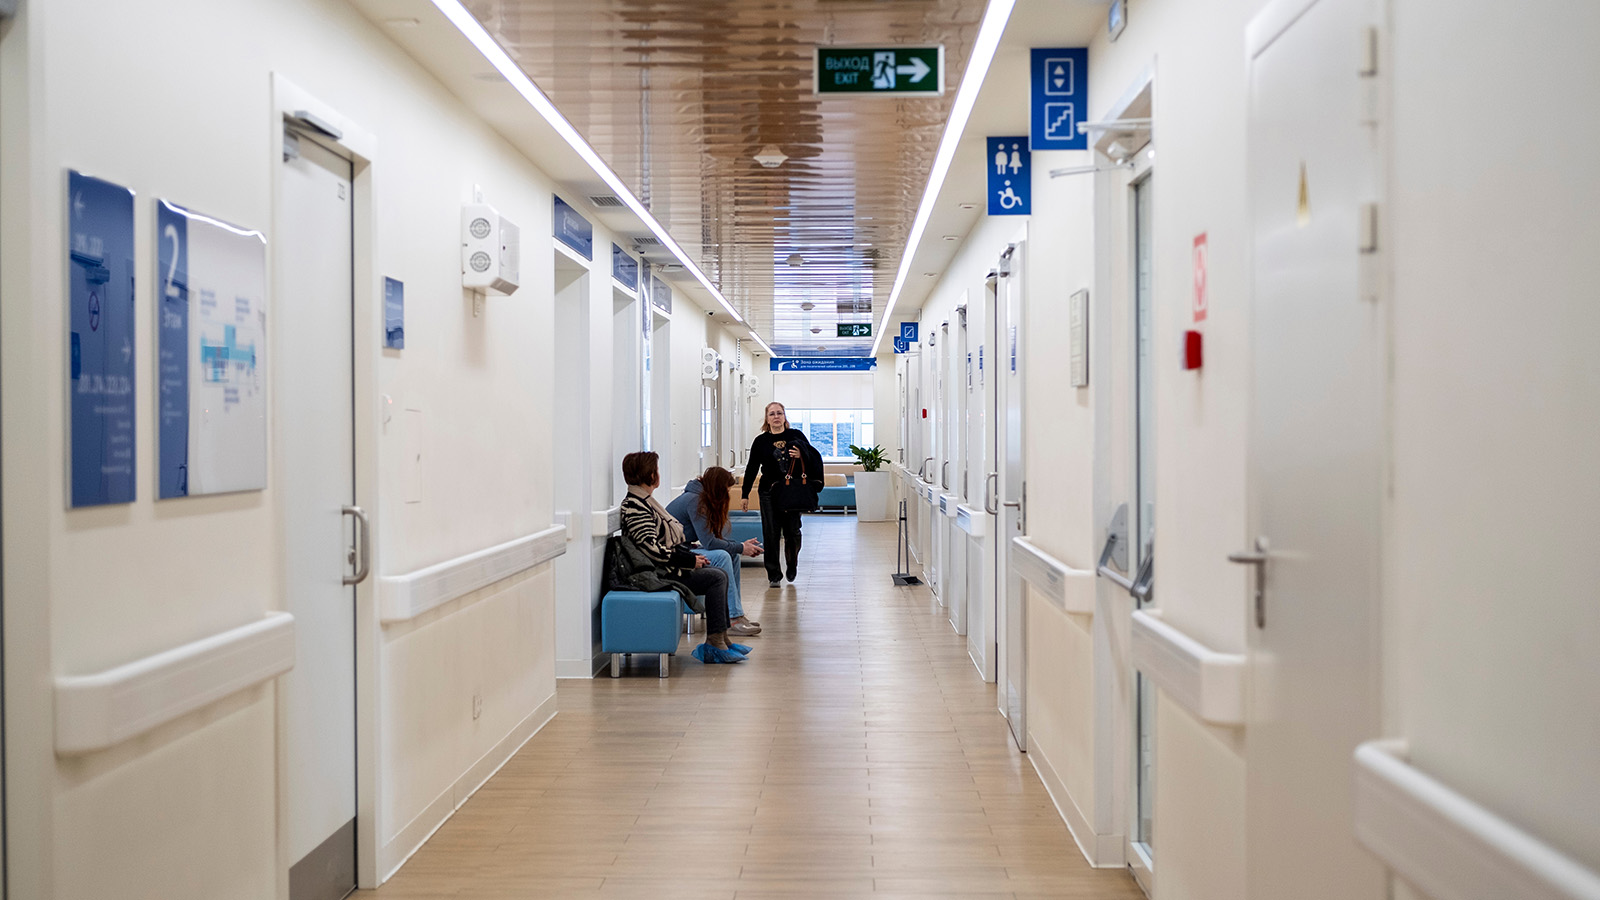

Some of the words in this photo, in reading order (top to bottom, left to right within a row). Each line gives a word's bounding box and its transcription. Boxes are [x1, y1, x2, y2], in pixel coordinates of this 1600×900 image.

[825, 56, 870, 71] ВЫХОД
[834, 72, 859, 85] EXIT
[164, 224, 179, 297] 2
